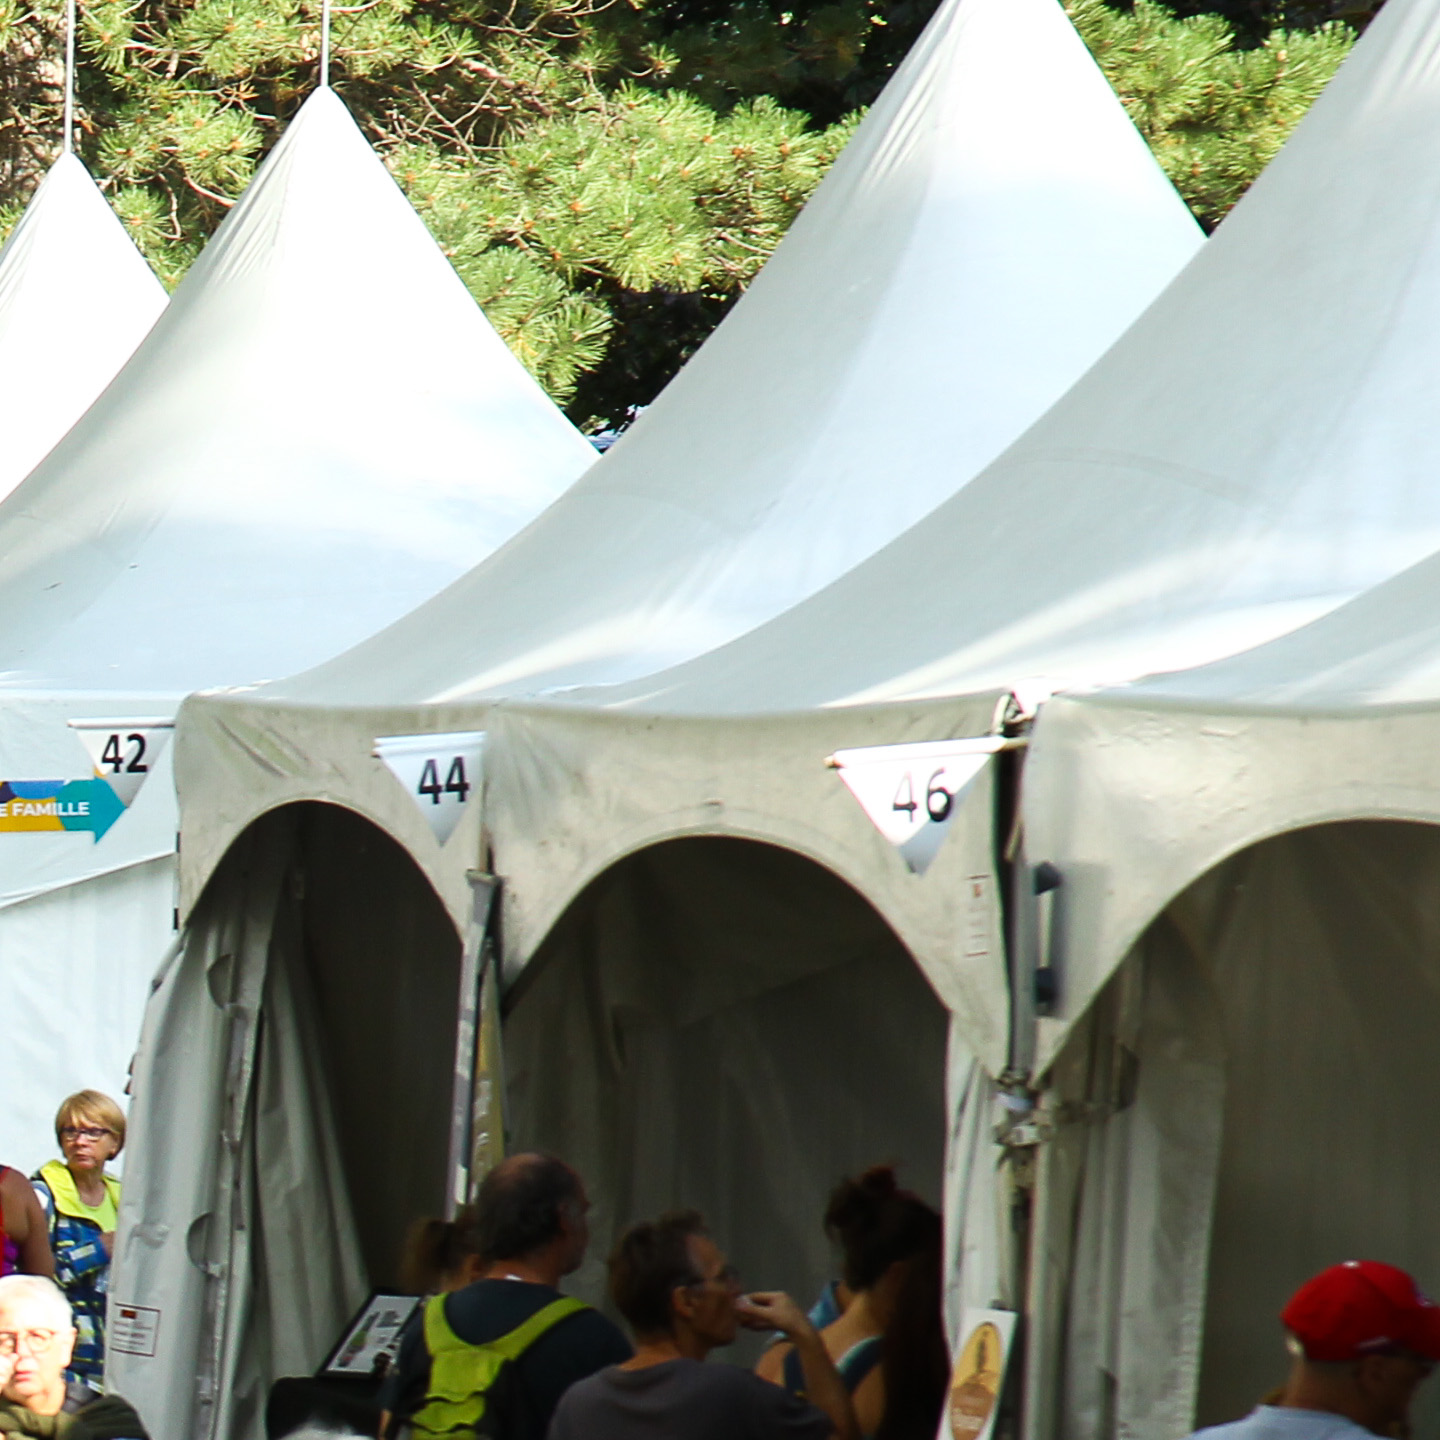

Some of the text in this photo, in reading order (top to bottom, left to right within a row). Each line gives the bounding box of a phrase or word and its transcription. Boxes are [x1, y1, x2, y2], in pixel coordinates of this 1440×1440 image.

[101, 733, 149, 774] 42
[417, 756, 471, 805] 44
[892, 767, 954, 824] 46
[12, 802, 90, 817] FAMILLE
